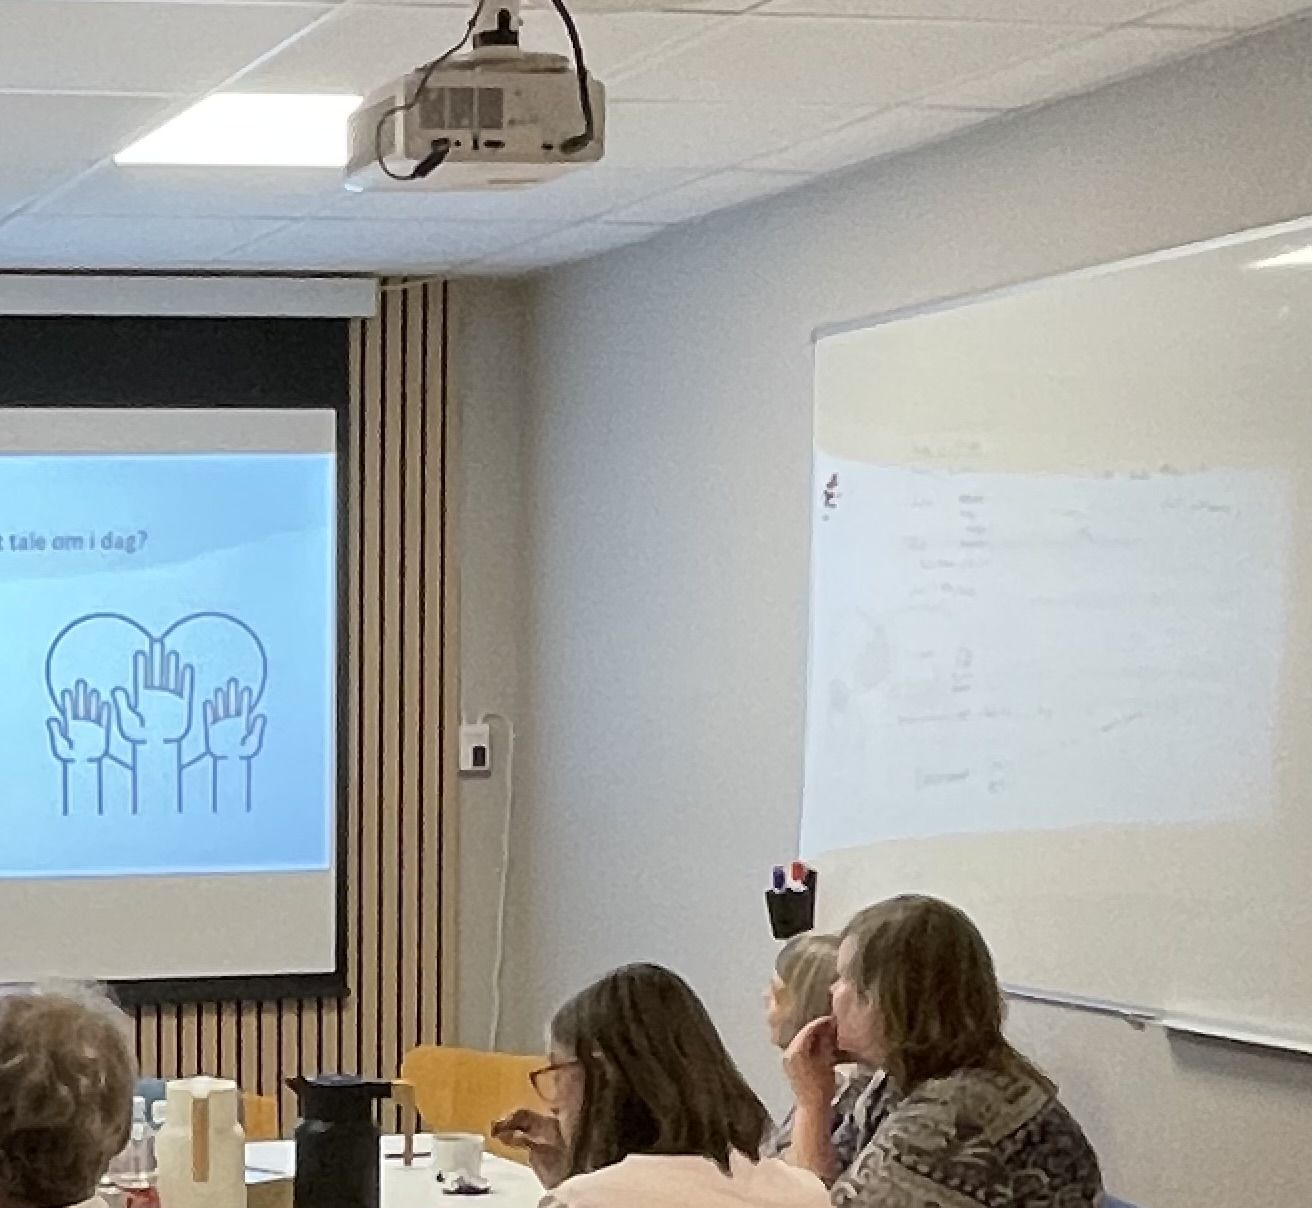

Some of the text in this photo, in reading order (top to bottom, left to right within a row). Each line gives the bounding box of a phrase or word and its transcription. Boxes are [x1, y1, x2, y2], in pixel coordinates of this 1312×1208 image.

[9, 531, 46, 552] tale
[51, 535, 84, 551] om
[88, 530, 96, 550] i
[100, 529, 148, 554] dag?
